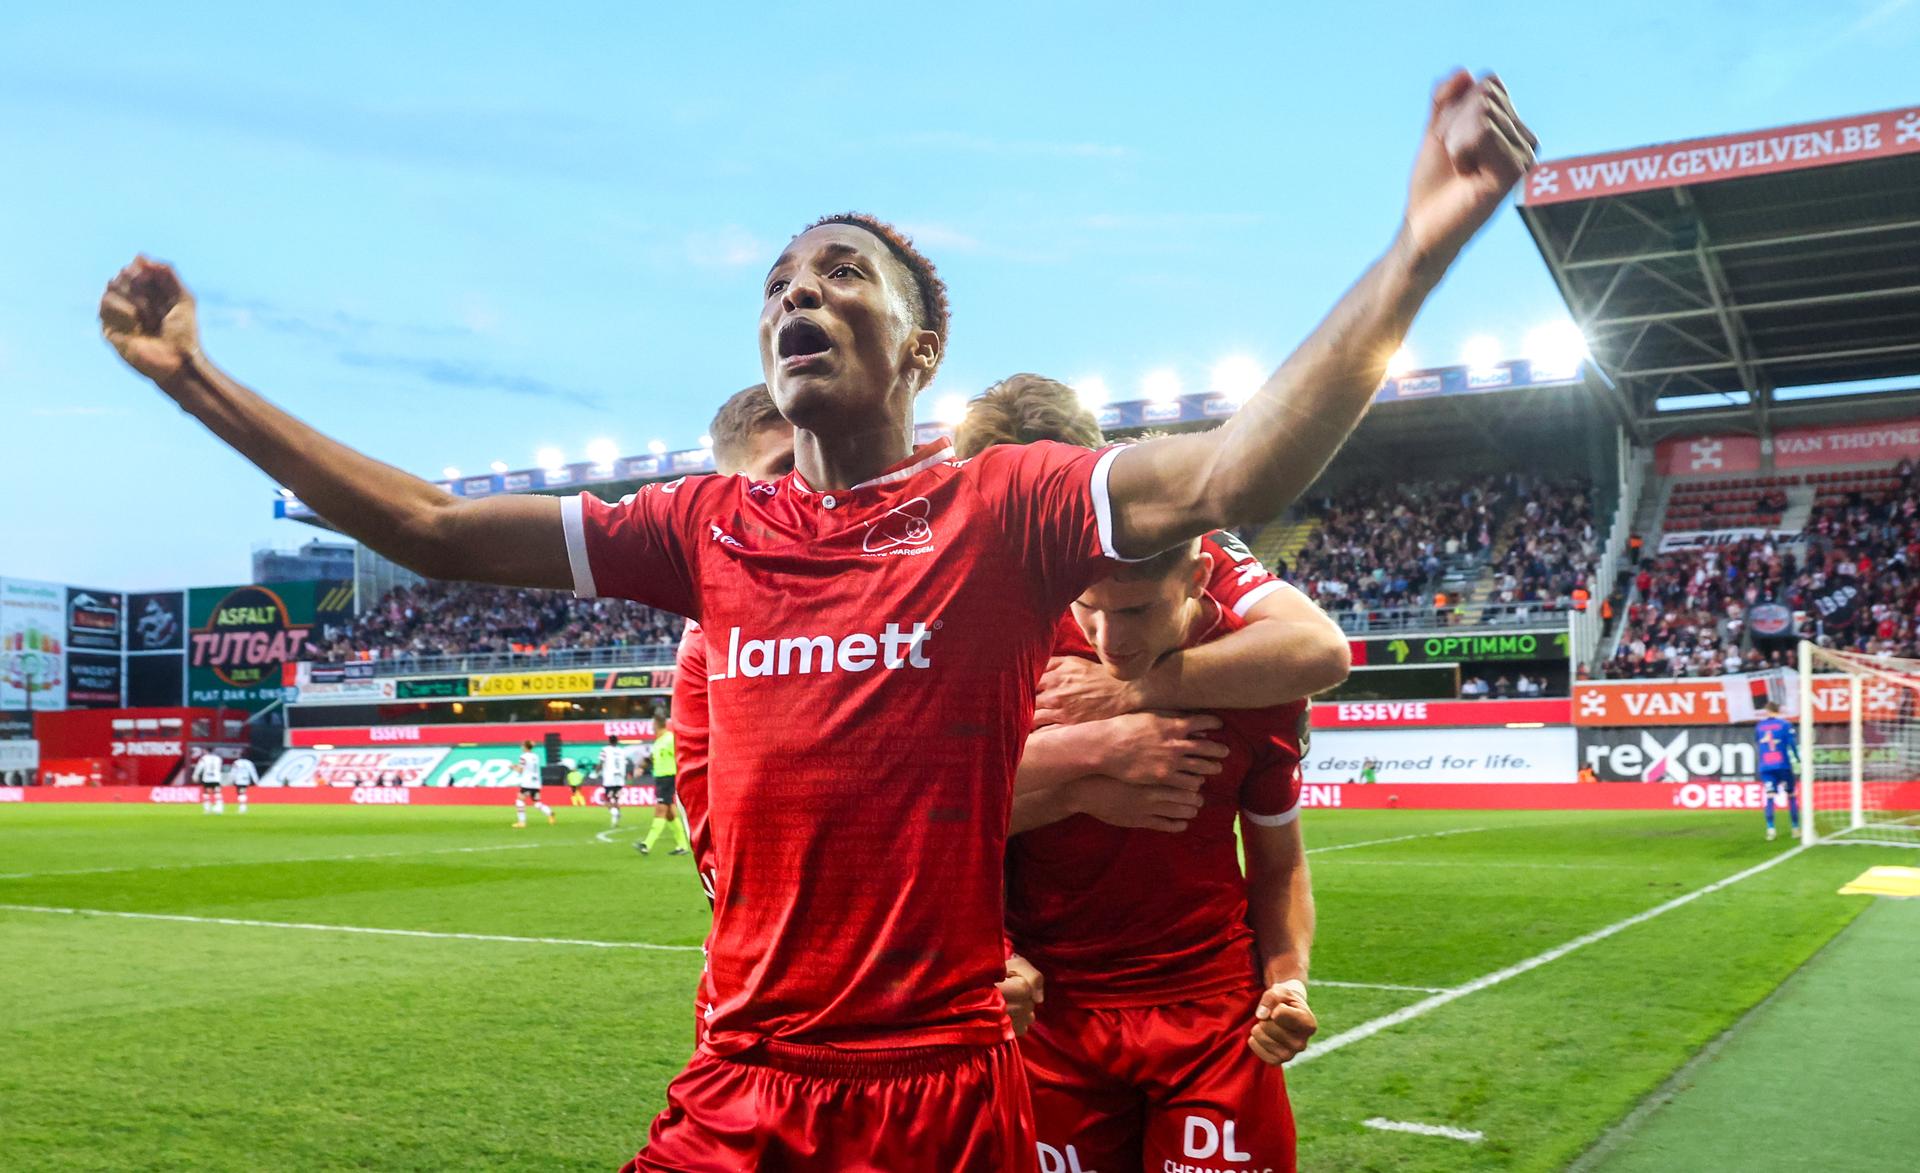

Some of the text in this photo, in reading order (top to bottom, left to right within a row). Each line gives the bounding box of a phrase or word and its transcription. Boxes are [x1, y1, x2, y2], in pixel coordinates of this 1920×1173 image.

[1568, 123, 1882, 191] WWW.GEWELVEN.BE
[1776, 437, 1822, 453] VAN
[889, 545, 935, 557] WAREGEM
[217, 606, 277, 625] ASFALT
[192, 629, 309, 666] TUTGAT
[1424, 635, 1537, 656] OPTIMMO
[521, 676, 590, 691] MODERN
[1337, 702, 1428, 721] ESSEVEE
[1621, 692, 1697, 716] VAN
[369, 726, 421, 740] ESSEVEE
[603, 720, 656, 736] ESSEVE
[127, 741, 183, 756] PATRICK
[1440, 756, 1478, 770] for
[1484, 754, 1532, 769] life.
[350, 787, 410, 804] OEREN!
[1184, 1115, 1251, 1162] DL
[1035, 1140, 1098, 1173] DL
